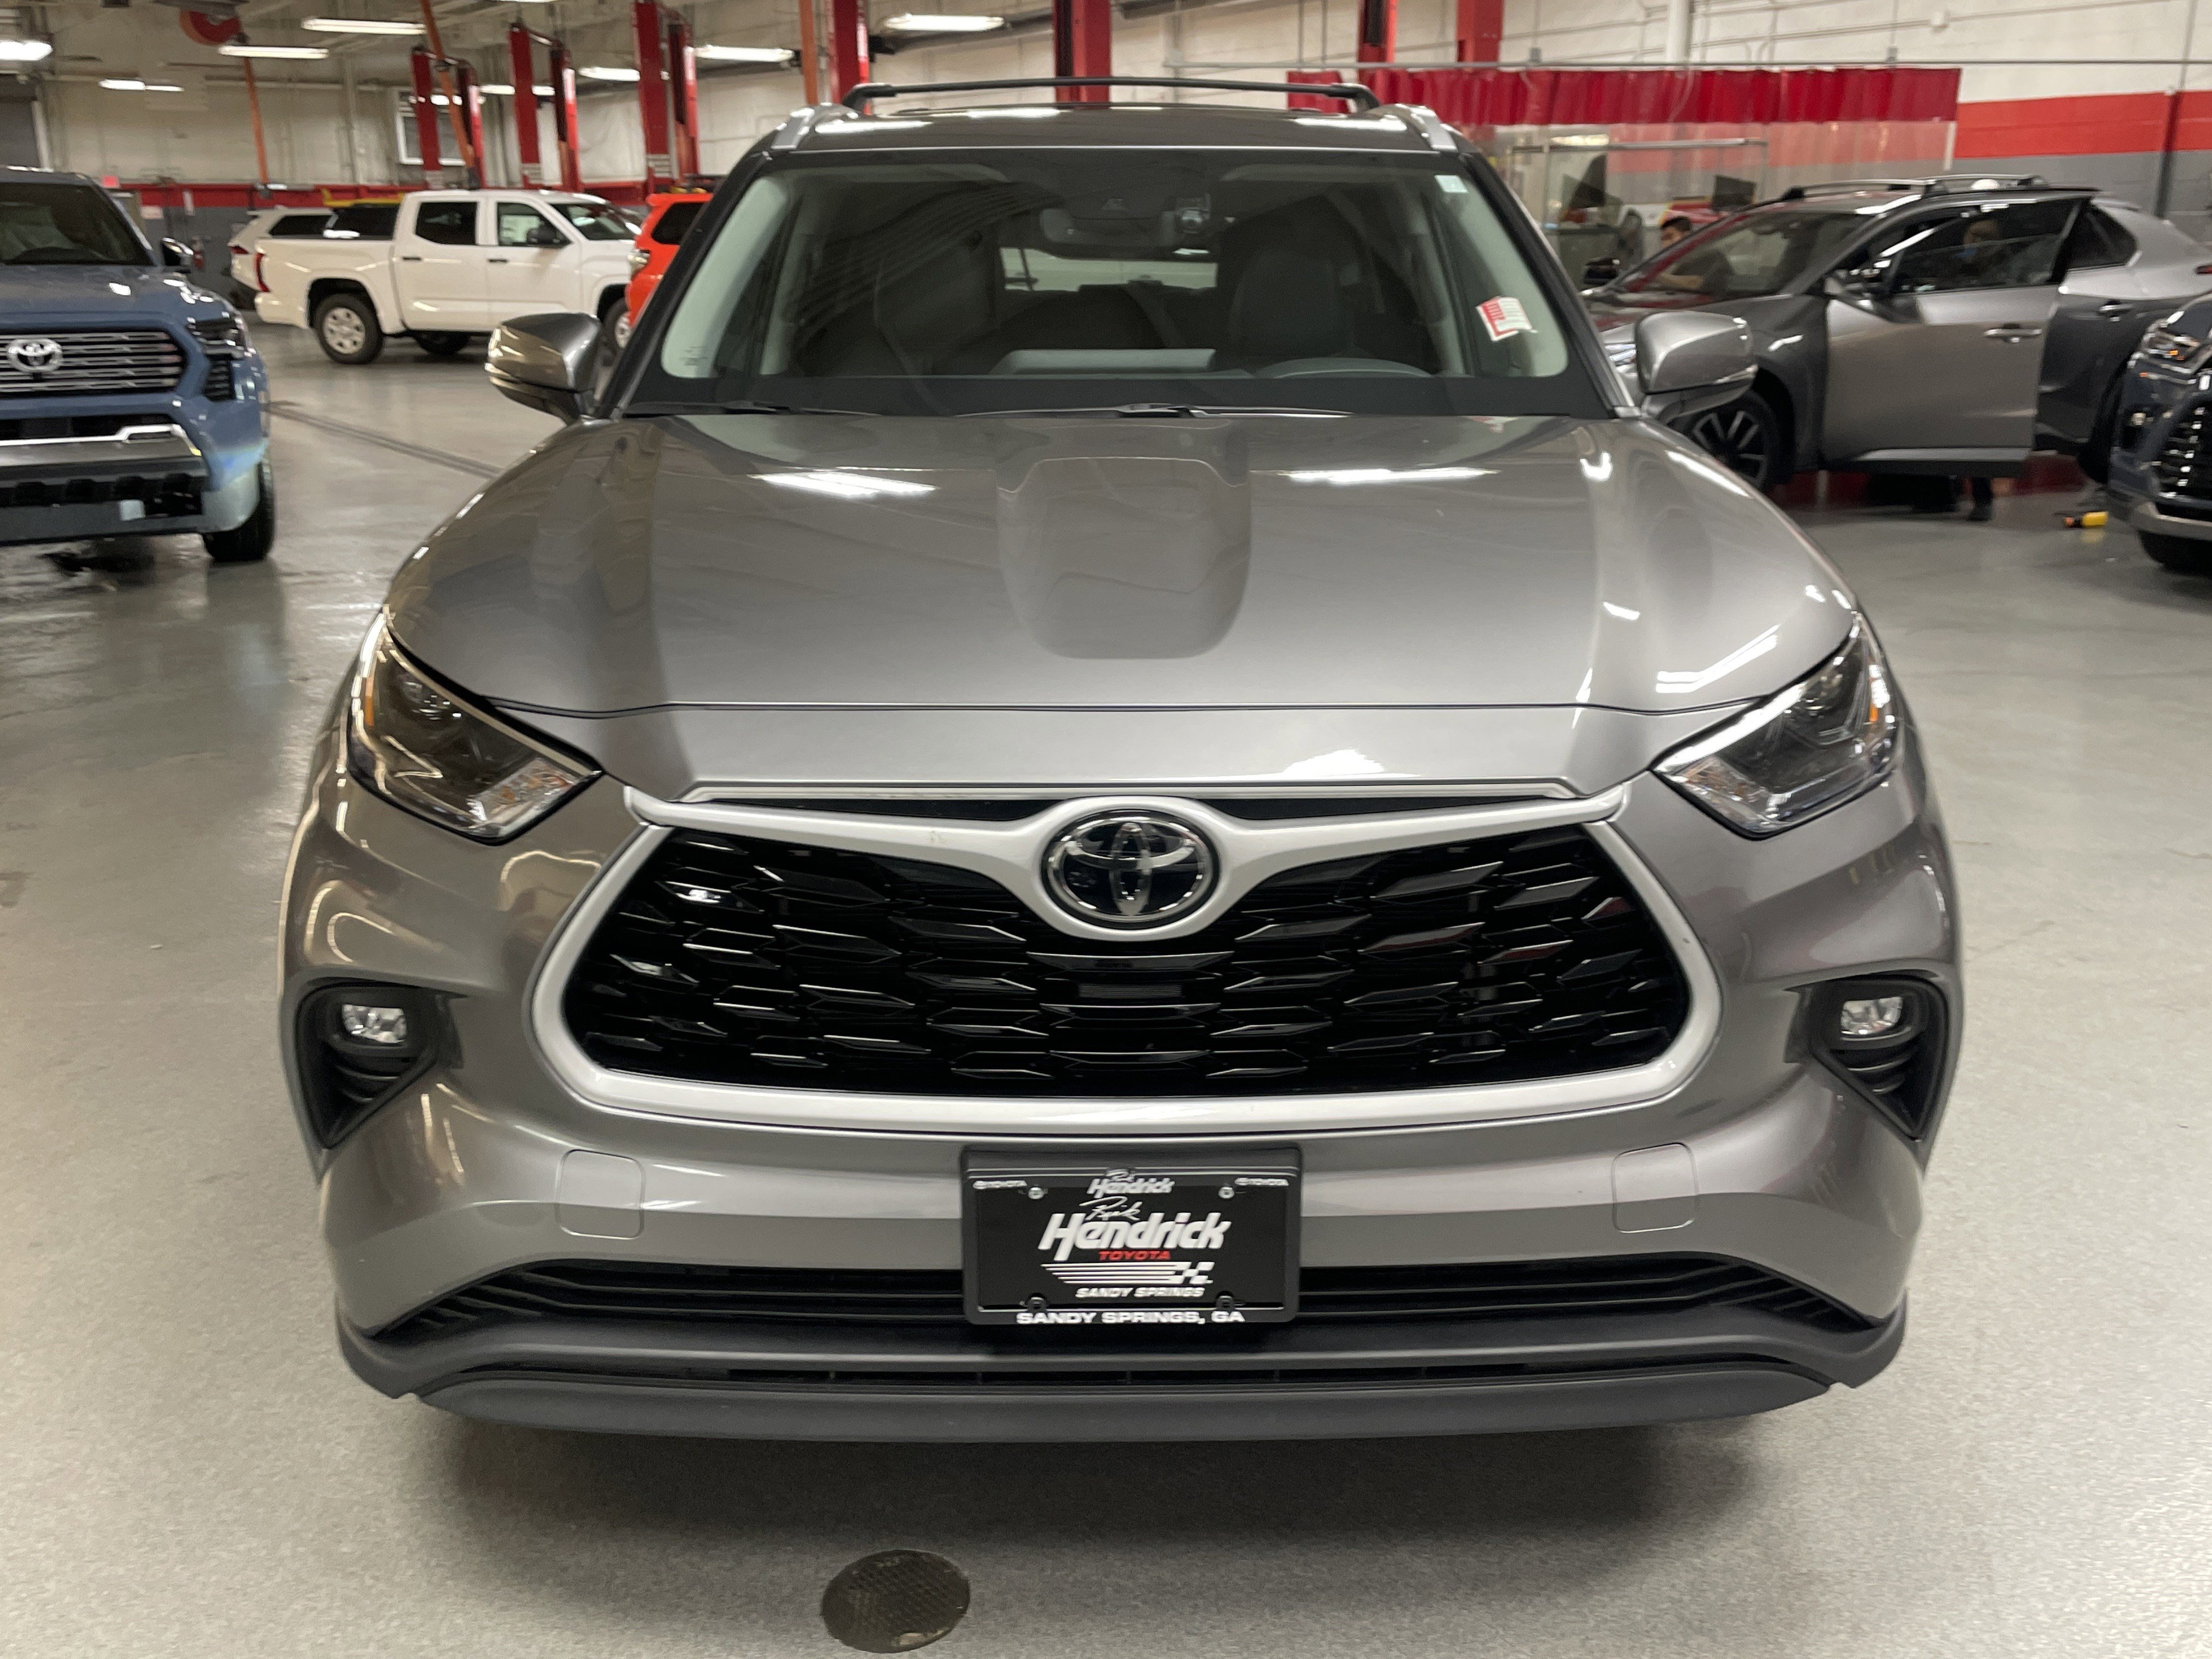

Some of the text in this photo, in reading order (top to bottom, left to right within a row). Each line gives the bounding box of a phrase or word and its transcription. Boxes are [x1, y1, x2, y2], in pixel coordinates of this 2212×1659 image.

[1086, 1178, 1176, 1199] Hendrick
[1037, 1212, 1232, 1261] Hendrick
[1099, 1250, 1171, 1261] TOYOTA
[1075, 1287, 1205, 1298] SANDY SPRINGS
[1016, 1311, 1245, 1324] SANDY SPRINGS, GA
